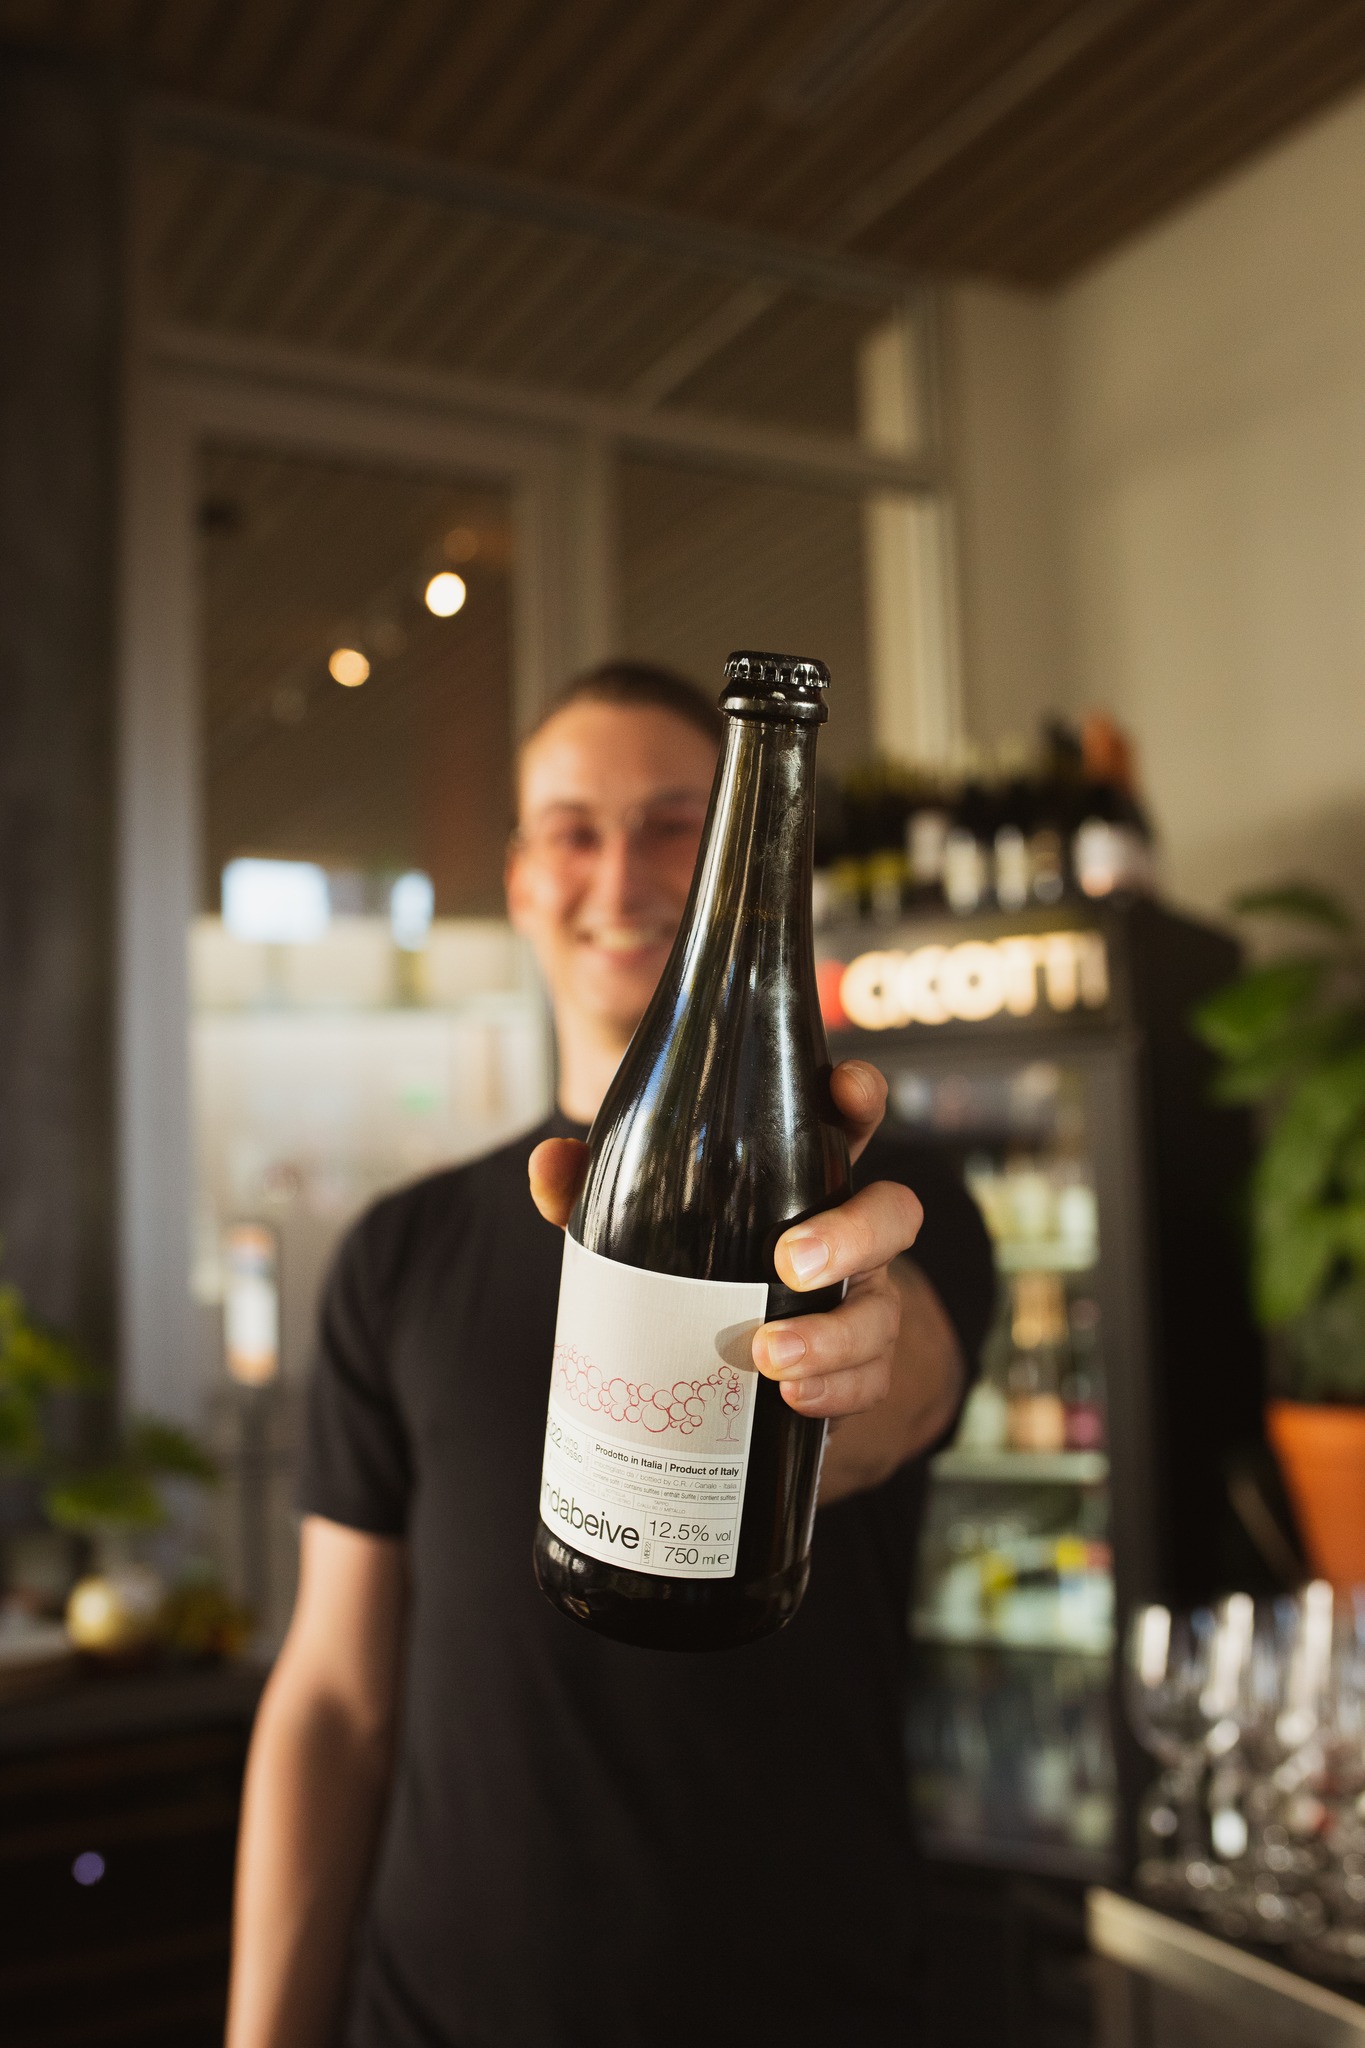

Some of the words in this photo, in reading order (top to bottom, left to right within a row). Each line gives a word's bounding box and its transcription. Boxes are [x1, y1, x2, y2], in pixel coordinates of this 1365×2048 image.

[595, 1444, 629, 1462] Prodotto
[630, 1456, 639, 1465] in
[641, 1458, 663, 1470] Italia
[670, 1463, 707, 1475] Product
[709, 1467, 719, 1476] of
[720, 1467, 740, 1477] Italy
[649, 1520, 709, 1541] 12.5%
[715, 1530, 731, 1541] vol
[664, 1546, 699, 1564] 750
[702, 1554, 715, 1565] ml
